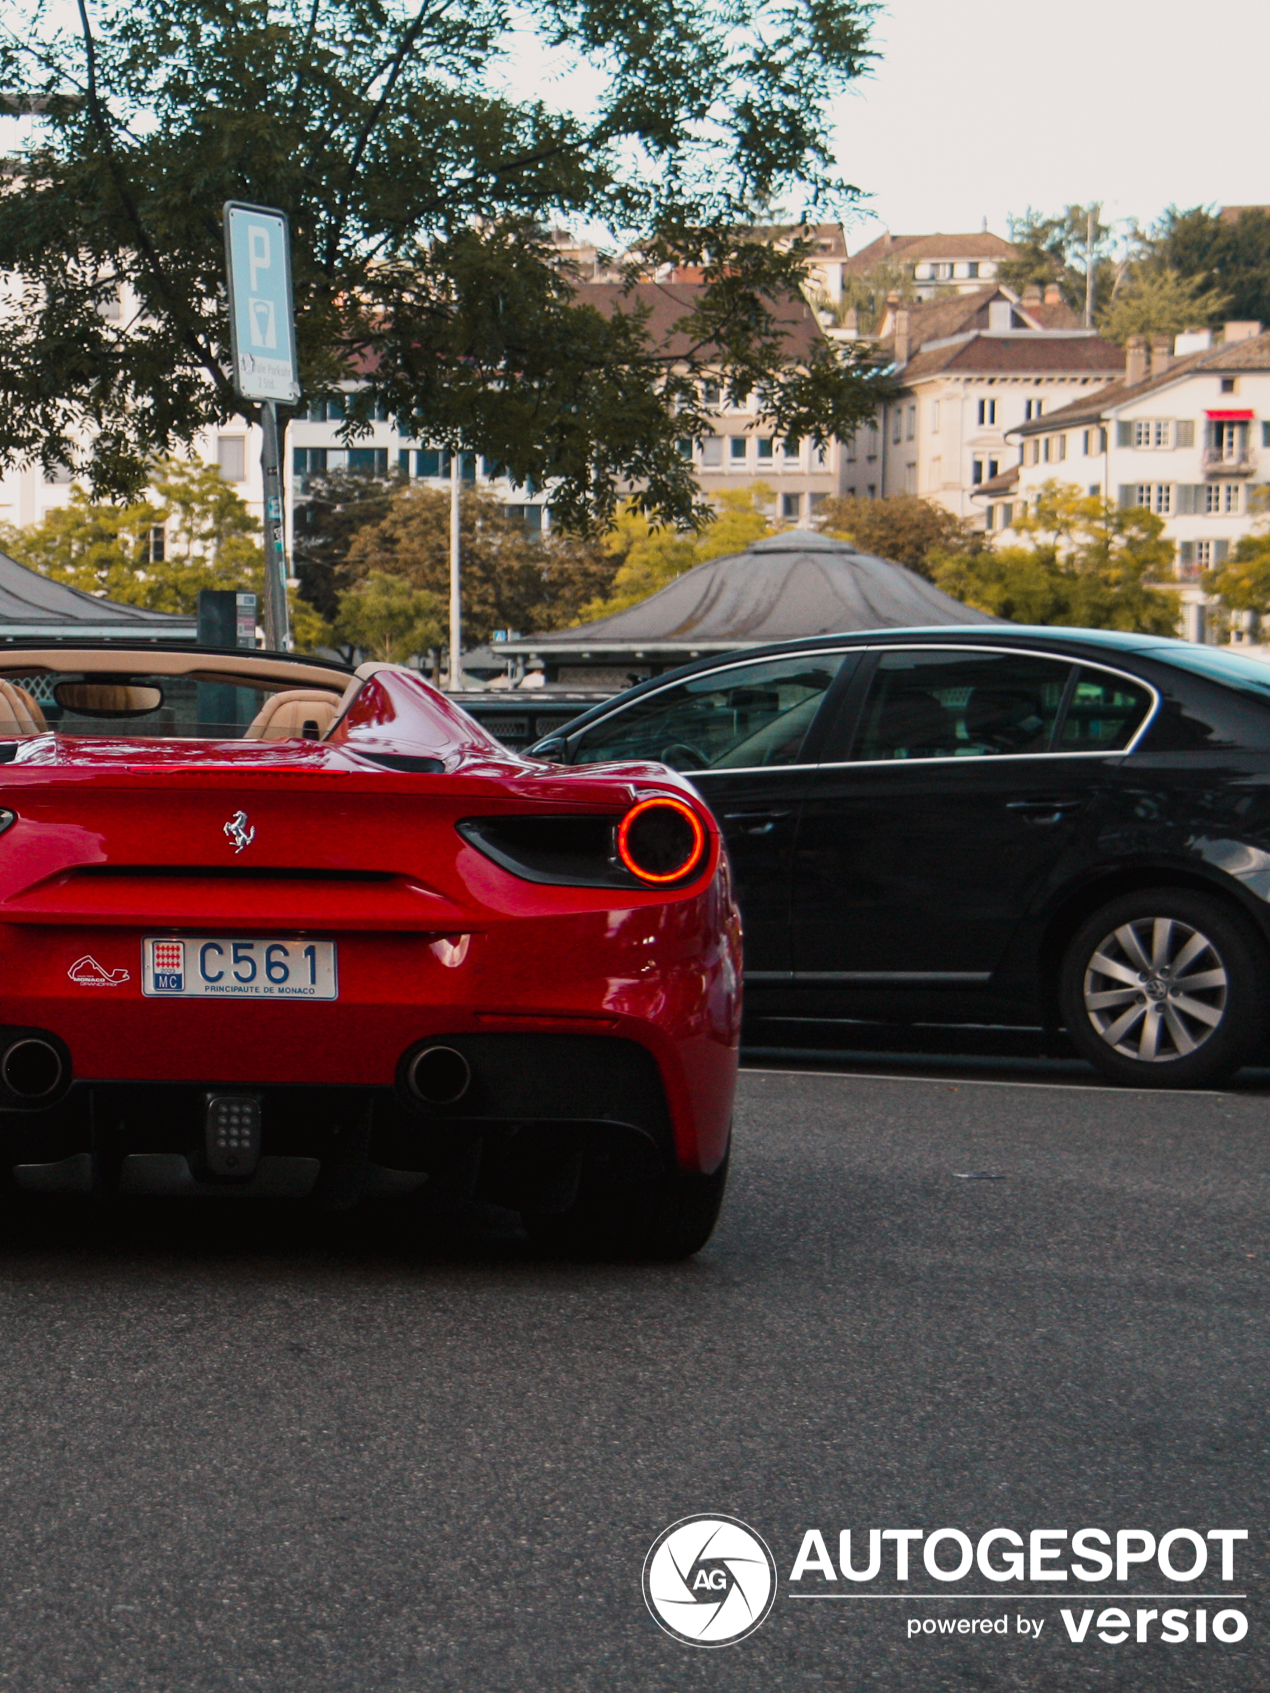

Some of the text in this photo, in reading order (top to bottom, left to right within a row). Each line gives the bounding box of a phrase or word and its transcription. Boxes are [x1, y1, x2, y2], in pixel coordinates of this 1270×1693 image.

[248, 225, 271, 292] P
[199, 942, 317, 985] C561
[158, 976, 177, 989] MC
[204, 985, 315, 995] PRINCIPAUTE DE MONACO
